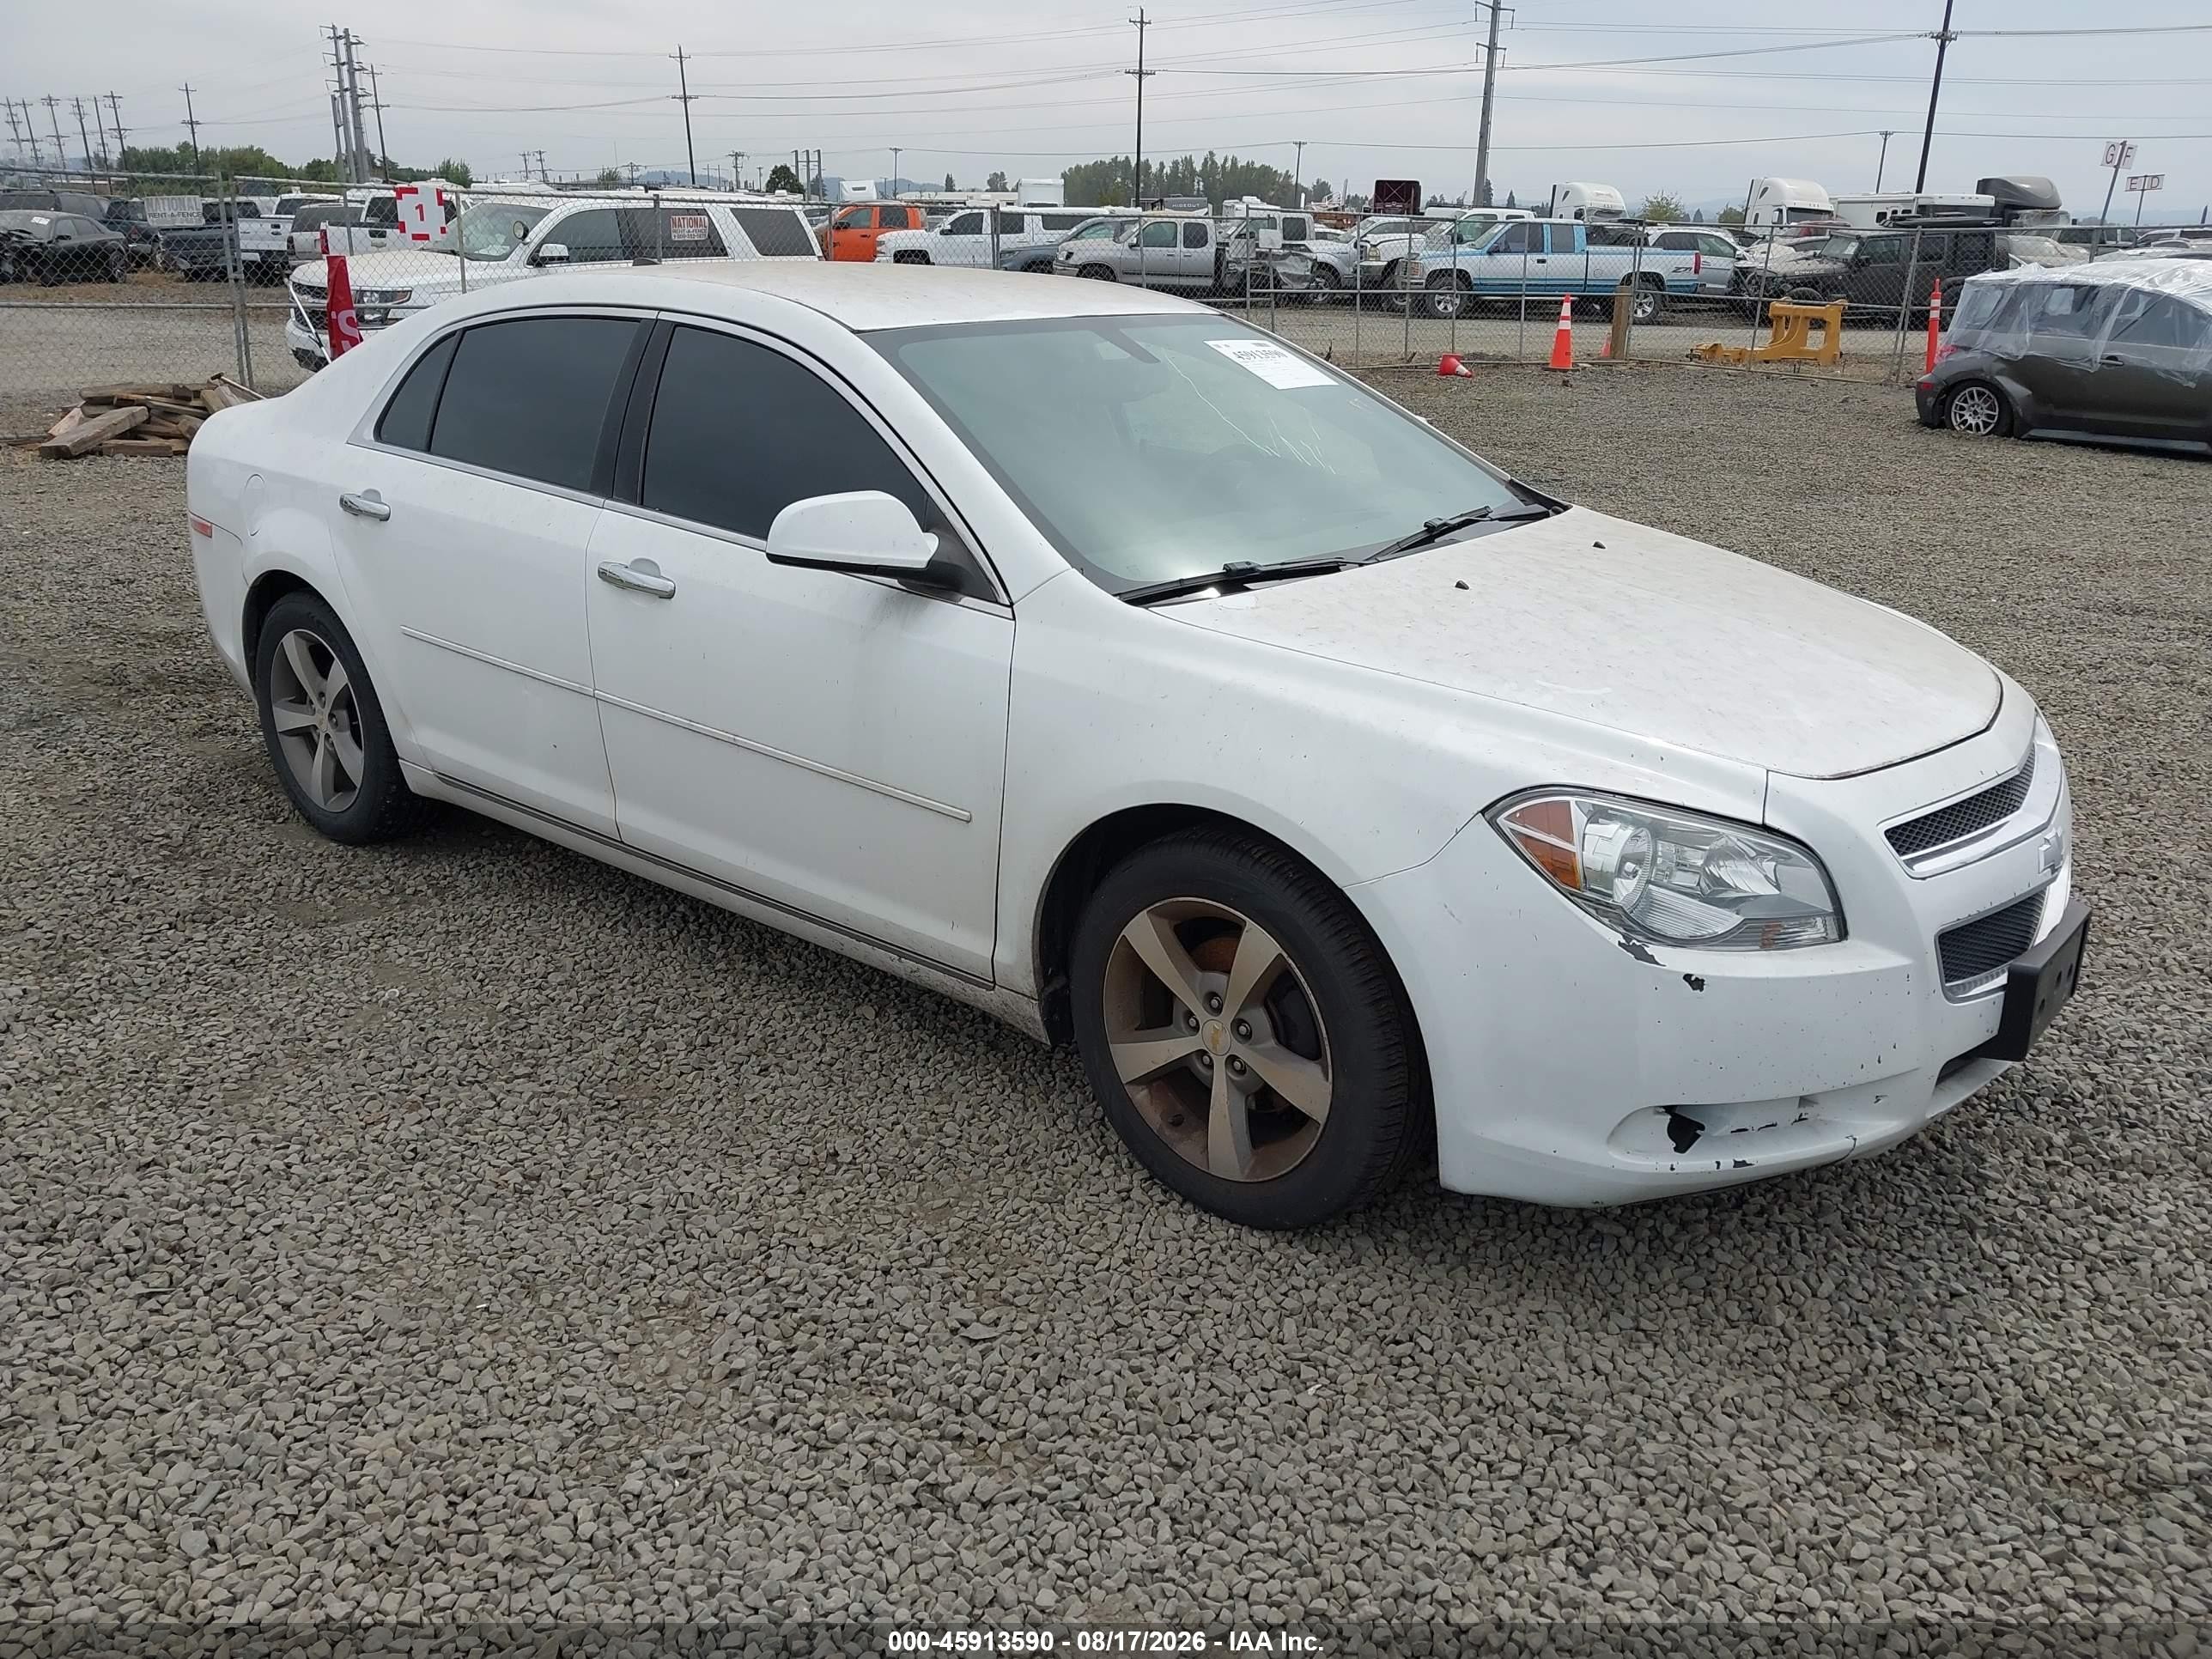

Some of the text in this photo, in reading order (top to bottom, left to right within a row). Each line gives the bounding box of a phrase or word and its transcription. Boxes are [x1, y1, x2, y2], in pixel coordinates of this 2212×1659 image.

[2106, 143, 2134, 166] G F
[2130, 176, 2160, 190] E D
[146, 198, 201, 212] NATIONAL
[415, 204, 424, 222] 1
[672, 216, 707, 228] NATIONAL
